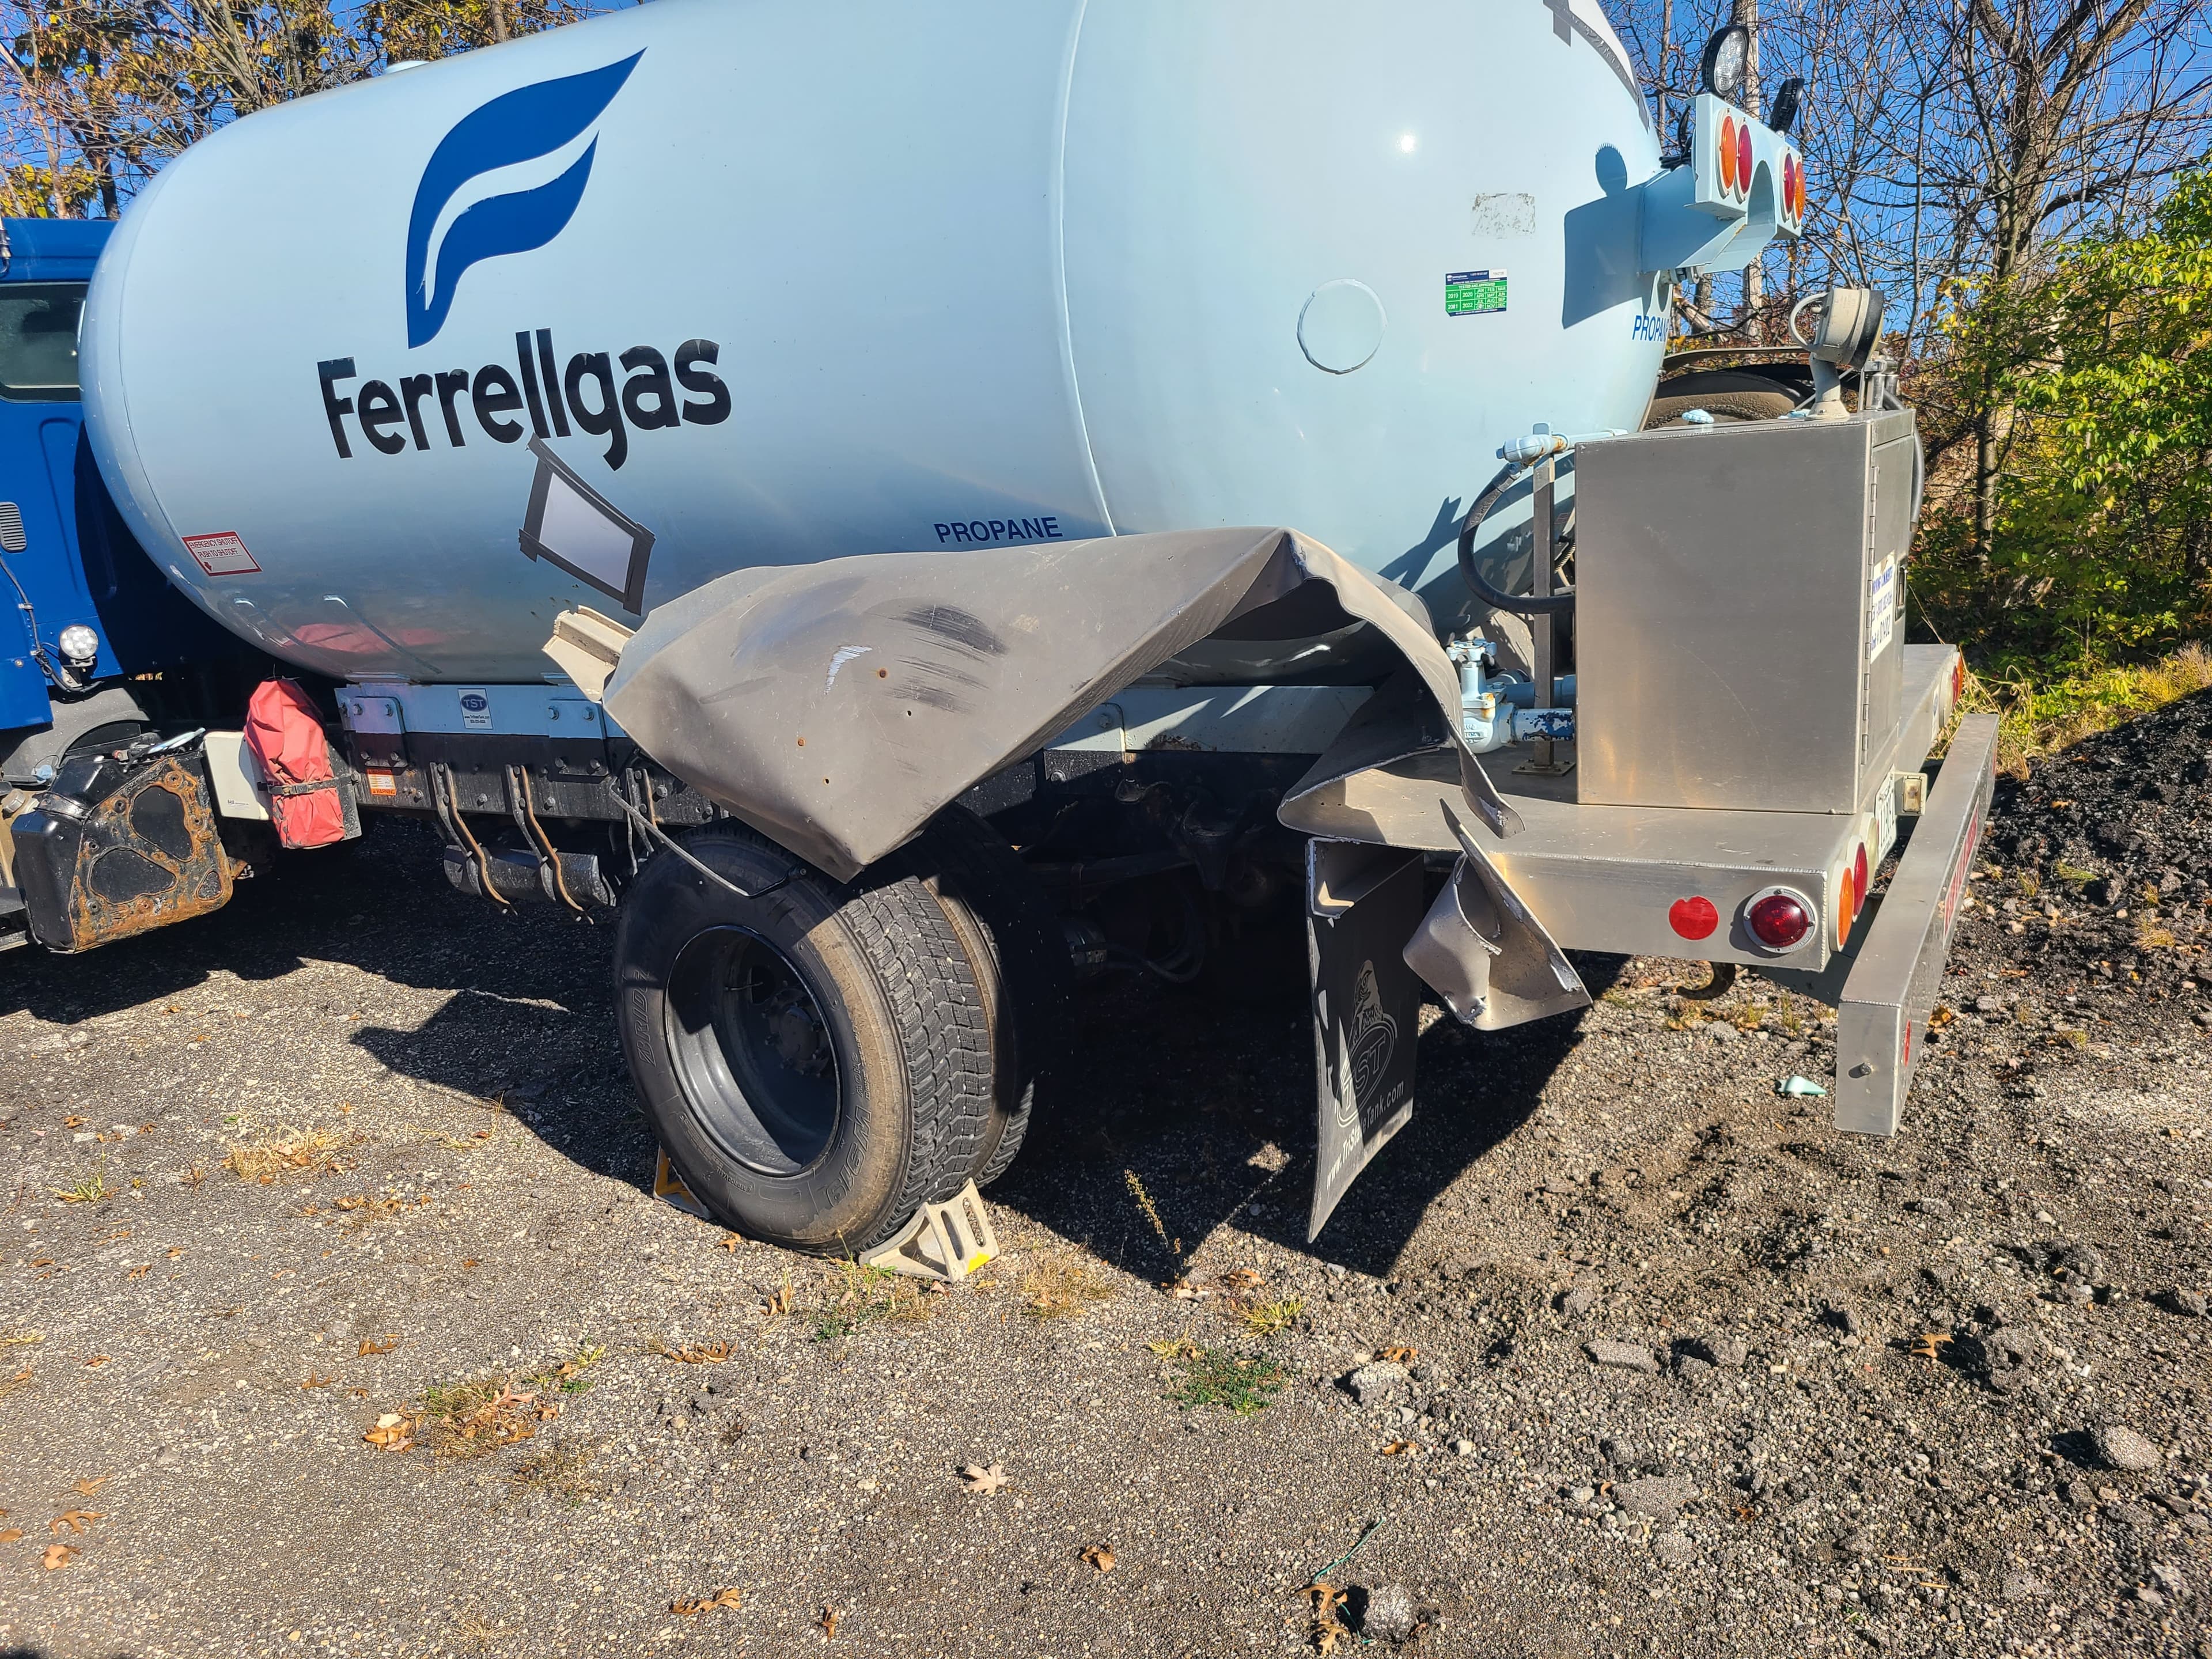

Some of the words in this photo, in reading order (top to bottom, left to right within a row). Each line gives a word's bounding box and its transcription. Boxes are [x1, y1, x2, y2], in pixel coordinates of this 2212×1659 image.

[317, 328, 732, 471] Ferrellgas
[934, 517, 1063, 543] PROPANE
[189, 540, 218, 549] EMERGENCY
[216, 537, 238, 546] SHUTOFF
[198, 550, 211, 558] PUSH
[217, 548, 238, 556] SHUTOFF
[463, 698, 484, 708] TST
[1343, 1033, 1386, 1112] TST
